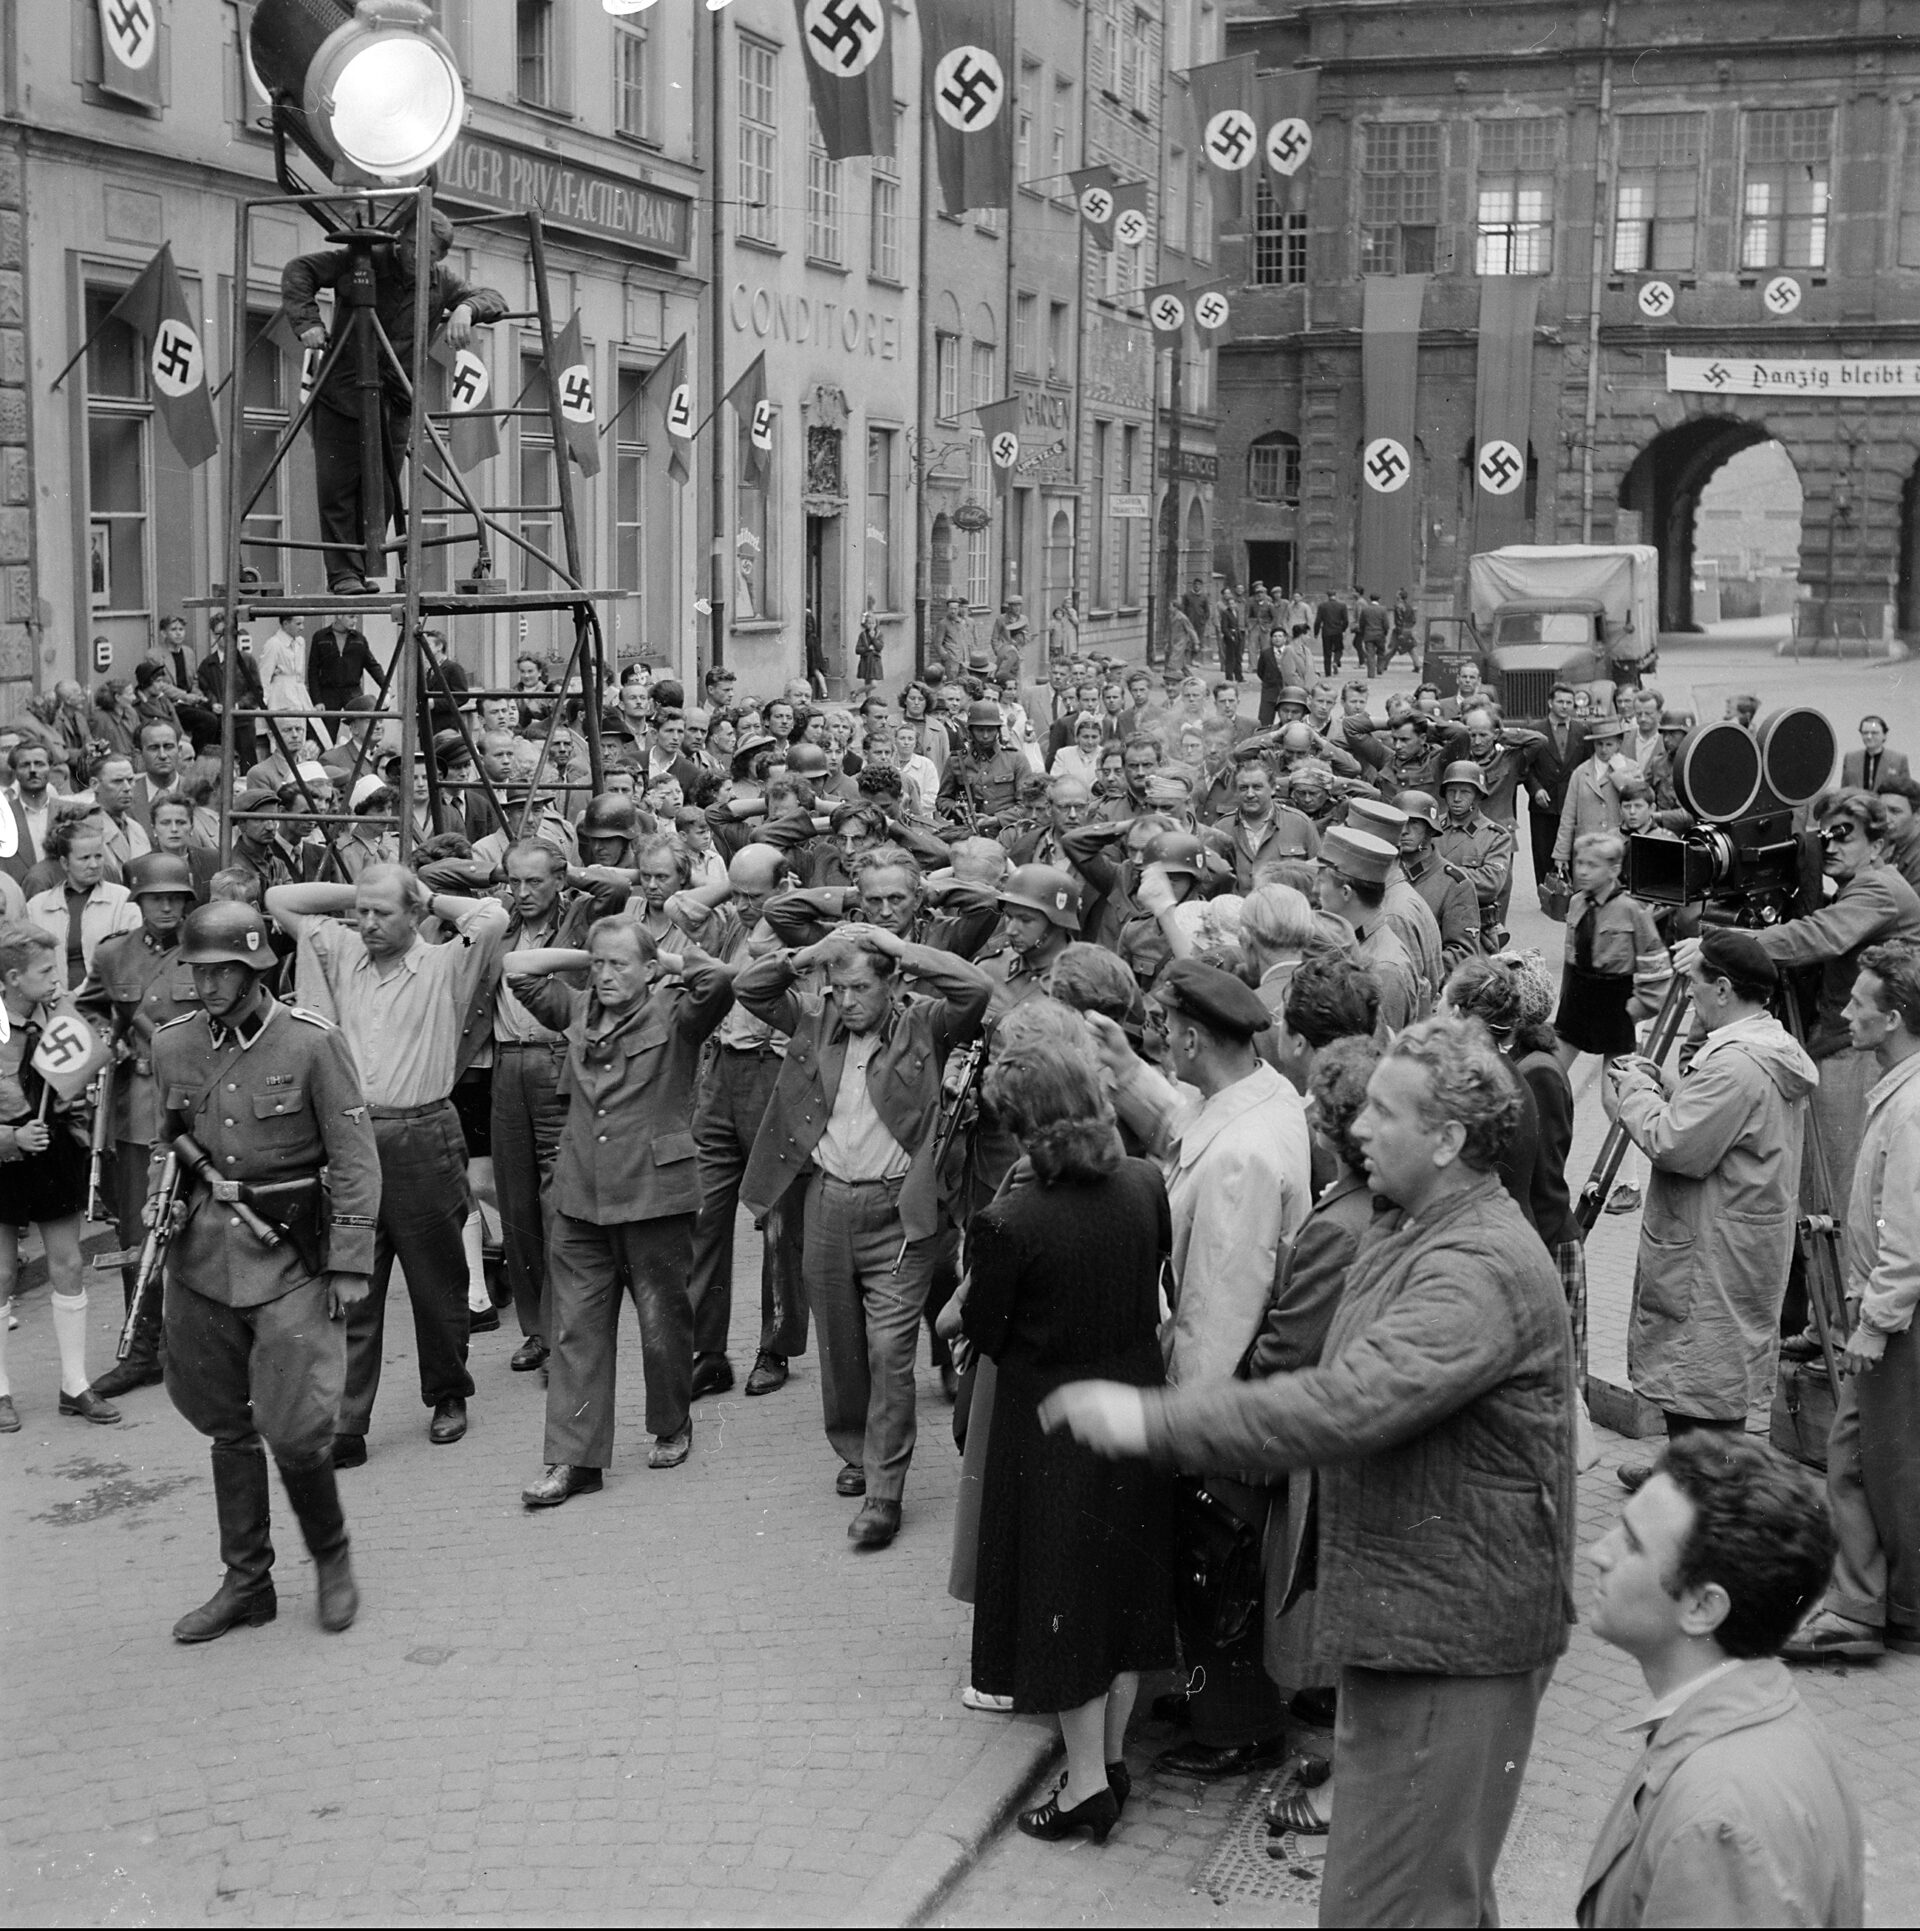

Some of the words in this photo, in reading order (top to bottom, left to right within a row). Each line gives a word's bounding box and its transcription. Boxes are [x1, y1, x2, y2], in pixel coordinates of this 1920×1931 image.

[437, 140, 502, 198] ZIGER
[636, 197, 678, 244] BANK
[731, 283, 902, 362] CONDITOREI
[1752, 364, 1830, 388] Danzig
[1840, 365, 1904, 384] bleibt
